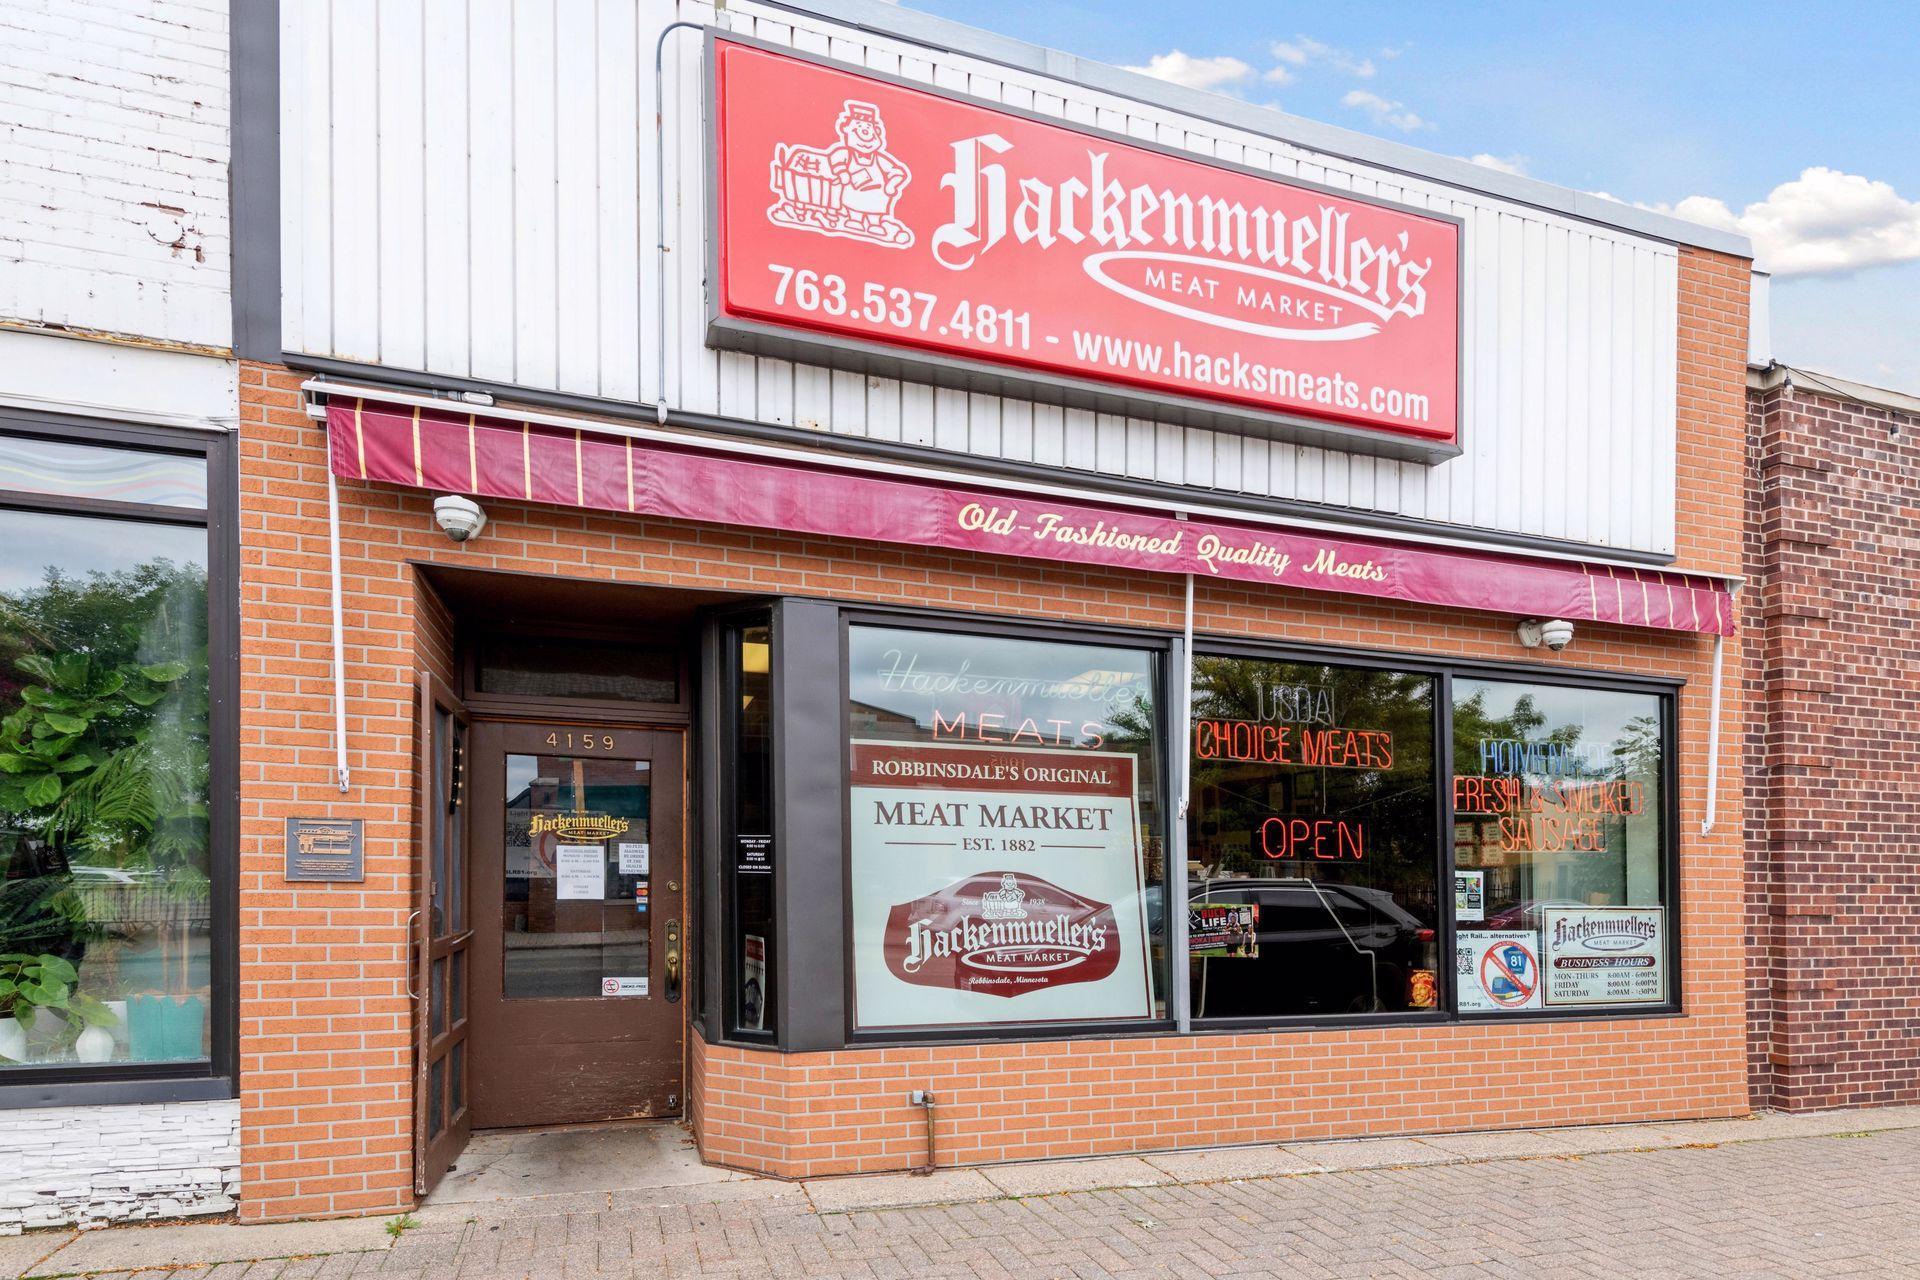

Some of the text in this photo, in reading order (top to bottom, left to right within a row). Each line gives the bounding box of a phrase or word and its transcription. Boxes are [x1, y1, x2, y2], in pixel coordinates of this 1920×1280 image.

[931, 133, 1432, 322] Hackenmueller's
[1145, 267, 1343, 326] MEAT MARKET
[768, 264, 1030, 350] 763.537.4811
[1073, 331, 1430, 421] www.hacksmeats.com
[1197, 534, 1291, 577] Quality
[1303, 549, 1388, 582] Meats
[1261, 686, 1332, 726] USDA
[546, 732, 615, 750] 4159
[933, 710, 1104, 750] MEATS
[1197, 720, 1393, 769] CHOICE MEATS
[872, 760, 1112, 785] ROBBINSDALE'S ORIGINAL
[1453, 777, 1520, 812] FRESH
[1554, 780, 1644, 815] SMOKED
[528, 814, 629, 838] Hackenmueller's
[874, 801, 1113, 831] MEAT MARKET
[1499, 816, 1607, 852] SAUSAGE
[962, 838, 1036, 852] EST. 1882
[1262, 817, 1364, 859] OPEN
[1202, 917, 1227, 927] LIFE
[1552, 915, 1657, 952] Hackenmueller's
[903, 915, 1107, 973] Hackenmueller's
[986, 952, 1070, 962] MEAT MARKET
[1510, 955, 1522, 967] 81
[968, 976, 1049, 985] Robbinsdale, Minnesota
[1560, 958, 1650, 968] BUSINESS HOURS
[1554, 990, 1590, 998] SATURDAY
